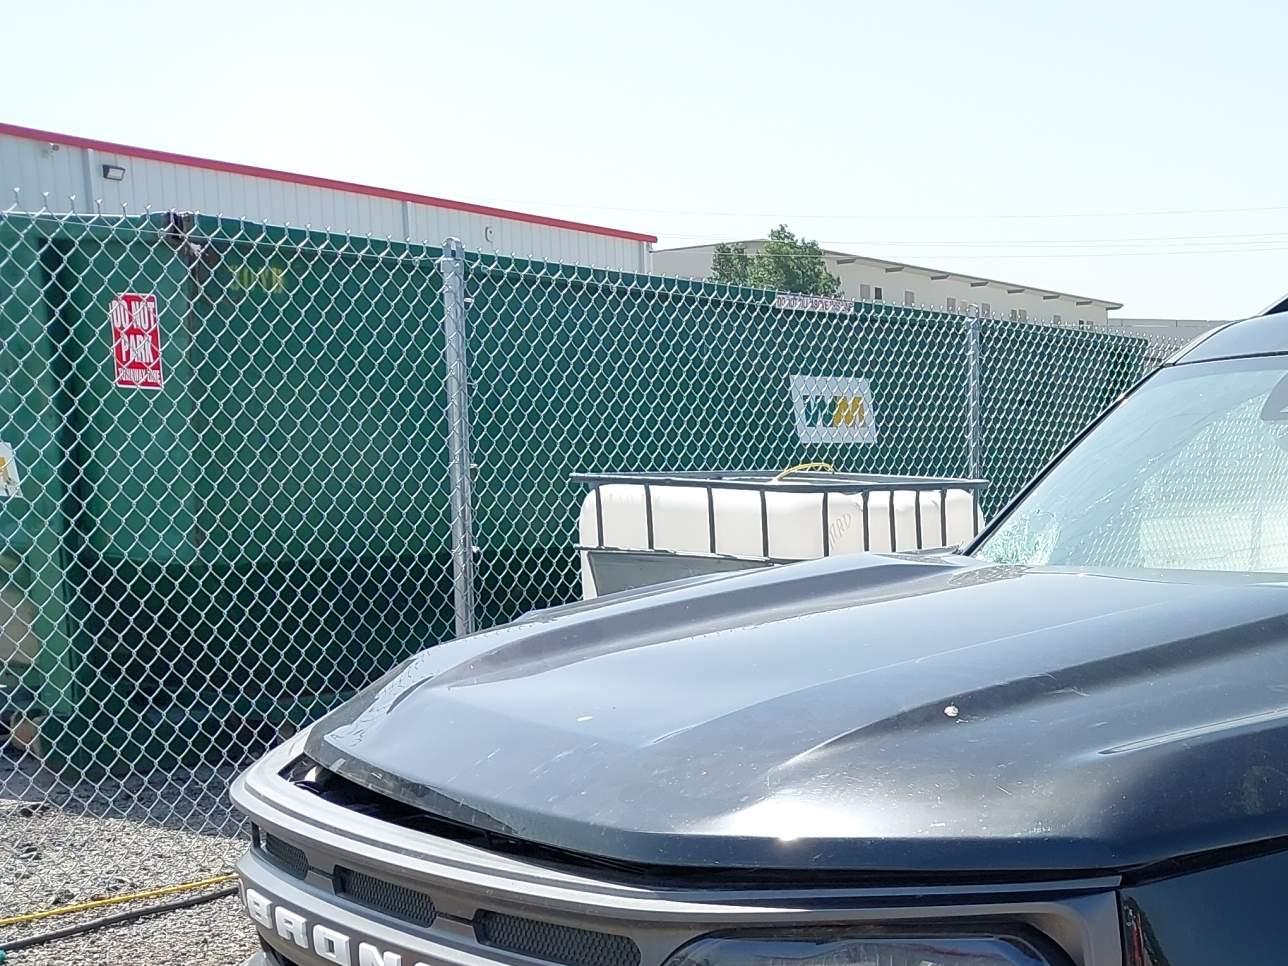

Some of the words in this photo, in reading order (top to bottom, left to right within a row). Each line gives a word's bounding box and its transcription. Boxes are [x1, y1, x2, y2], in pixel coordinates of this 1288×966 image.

[111, 300, 130, 329] DO
[131, 301, 156, 330] NOT
[121, 335, 153, 363] PARK
